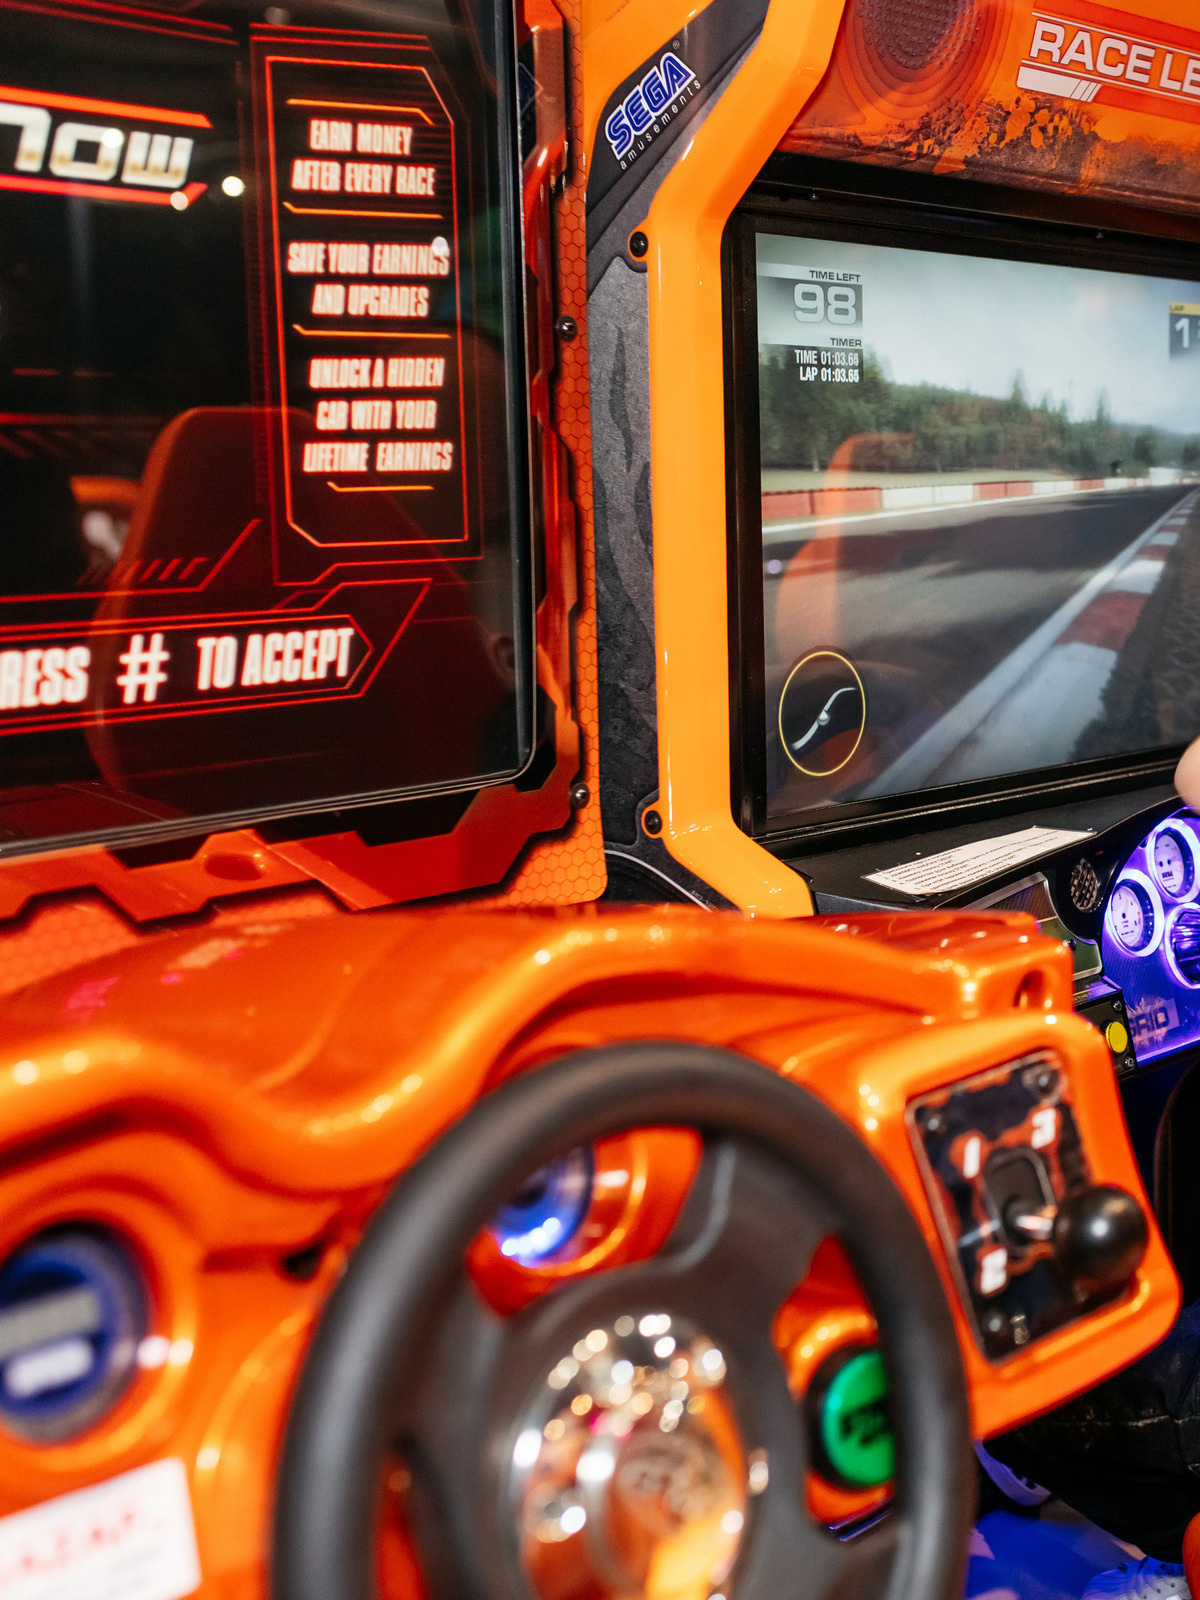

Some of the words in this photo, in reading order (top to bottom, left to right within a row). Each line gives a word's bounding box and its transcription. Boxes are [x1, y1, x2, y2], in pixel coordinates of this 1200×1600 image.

[1030, 20, 1156, 84] RACE
[604, 51, 697, 160] SEGA
[310, 119, 353, 152] EARN
[356, 122, 413, 156] MONEY
[620, 79, 701, 170] amusements
[291, 159, 342, 191] AFTER
[344, 162, 393, 194] EVERY
[396, 165, 436, 196] RACE
[287, 242, 326, 274] SAVE
[328, 243, 370, 274] YOUR
[372, 244, 450, 276] EARNINGS
[809, 270, 834, 280] TIME
[837, 273, 860, 282] LEFT
[311, 283, 346, 316] AND
[347, 284, 429, 317] UPGRADES
[794, 283, 856, 325] 98
[830, 338, 862, 347] TIMER
[1175, 317, 1190, 348] 1
[309, 357, 372, 388] UNLOCK
[371, 357, 385, 388] A
[386, 357, 445, 388] HIDDEN
[794, 349, 818, 365] TIME
[799, 366, 818, 381] LAP
[316, 400, 349, 431] CAR
[351, 400, 393, 430] WITH
[395, 400, 438, 430] YOUR
[302, 442, 370, 473] LIFETIME
[375, 441, 454, 472] EARNINGS
[197, 635, 238, 691] TO
[241, 627, 355, 688] ACCEPT
[1031, 1106, 1057, 1150] 3
[962, 1136, 981, 1179] 1
[980, 1247, 1008, 1295] 2
